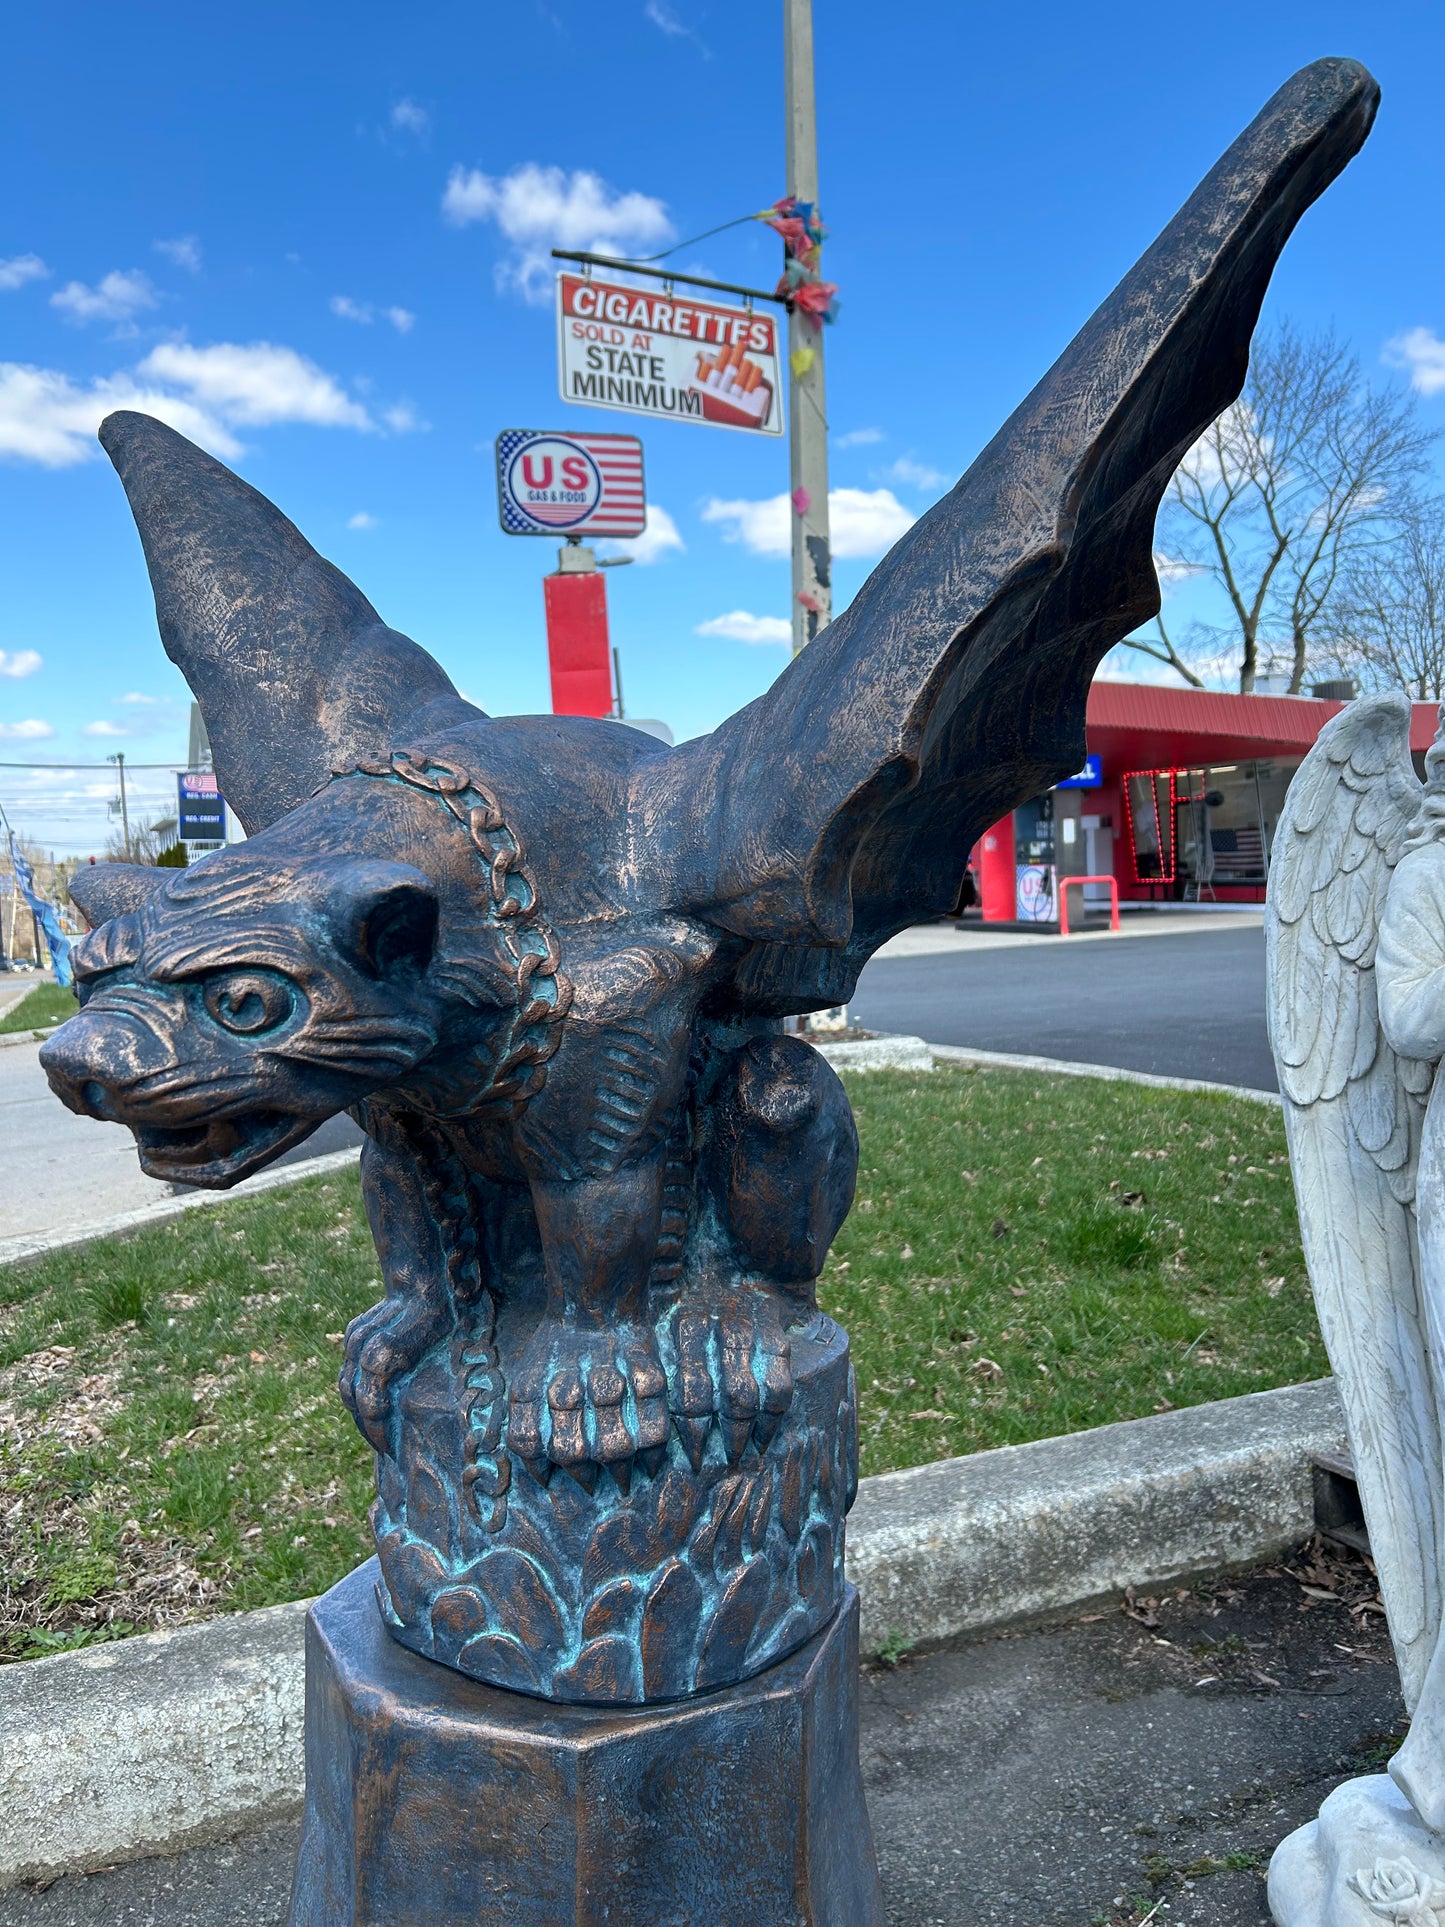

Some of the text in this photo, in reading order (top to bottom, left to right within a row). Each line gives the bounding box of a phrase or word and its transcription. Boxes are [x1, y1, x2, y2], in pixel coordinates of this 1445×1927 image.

[571, 321, 654, 351] SOLD AT
[572, 286, 769, 350] CIGARETTES
[586, 345, 666, 382] STATE
[572, 370, 702, 416] MINIMUM
[522, 455, 589, 490] US
[527, 490, 587, 503] GAS & FOOD
